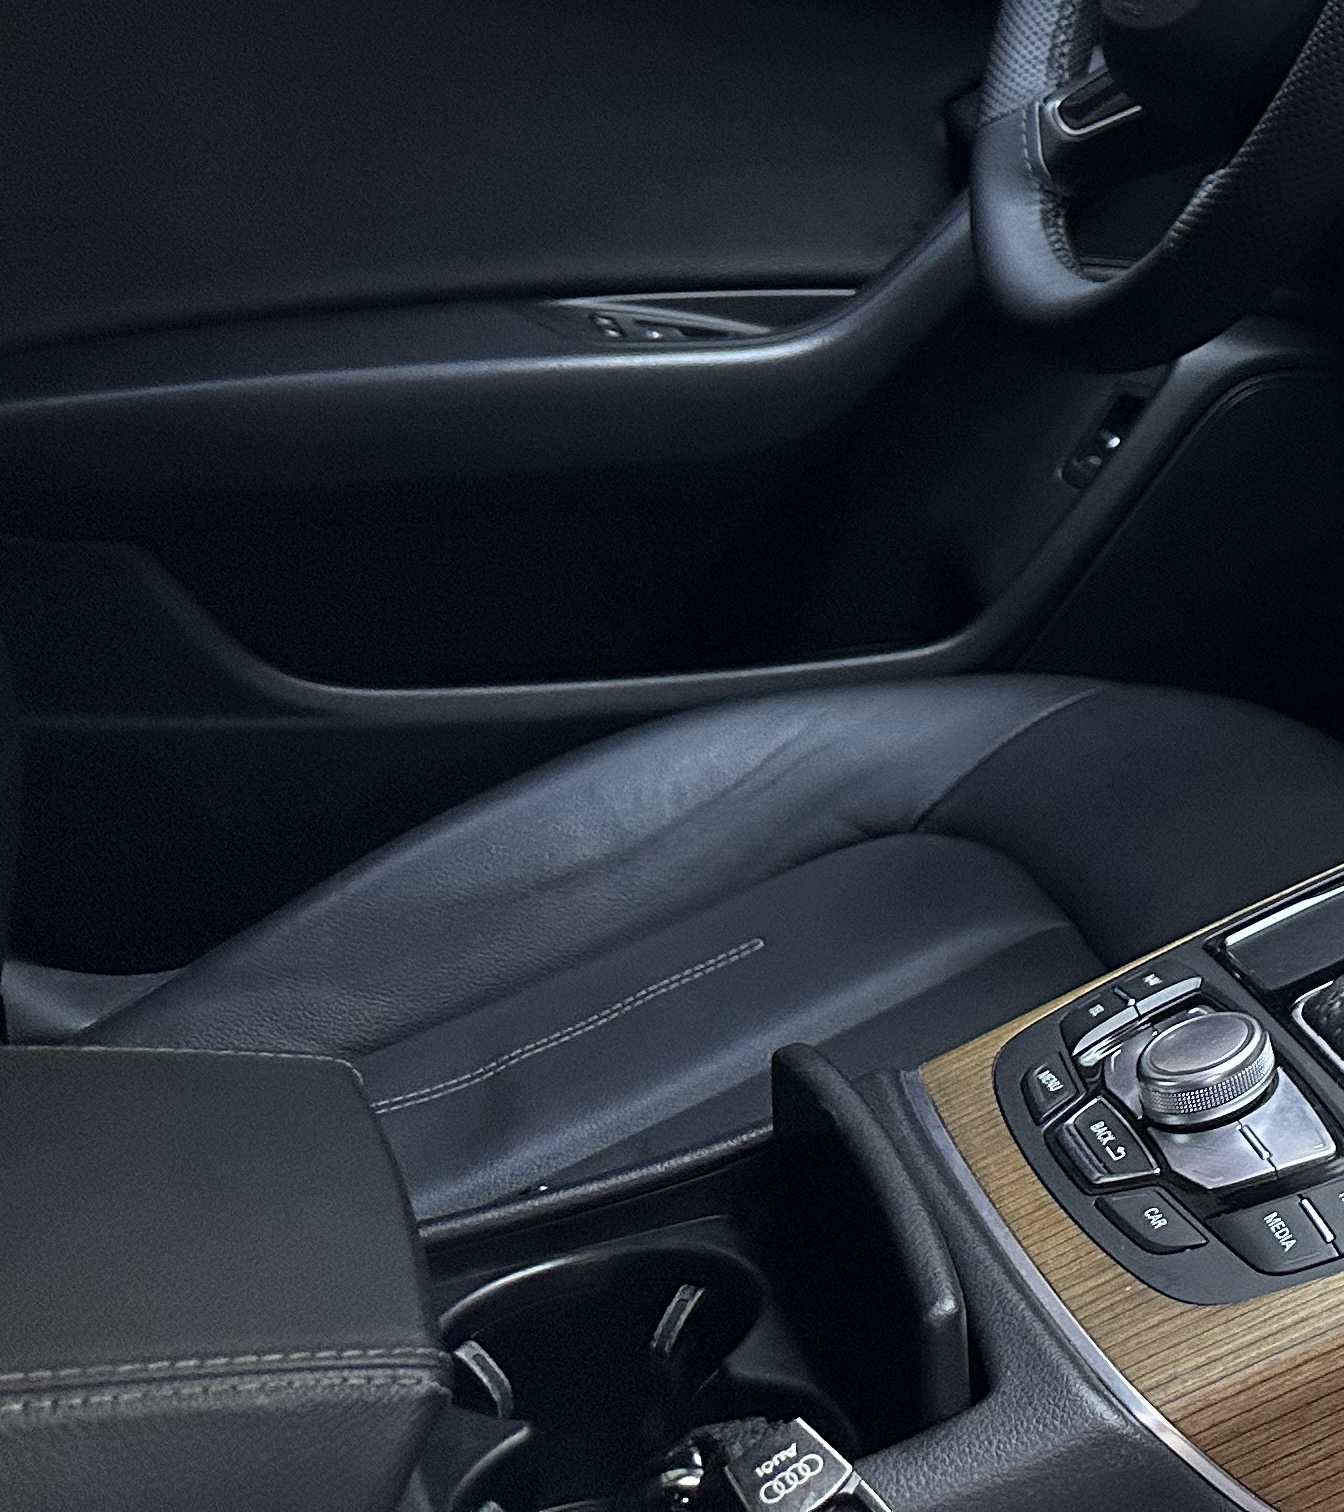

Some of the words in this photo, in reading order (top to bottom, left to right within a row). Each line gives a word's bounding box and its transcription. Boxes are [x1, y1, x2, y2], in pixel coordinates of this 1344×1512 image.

[1037, 1068, 1064, 1093] MENU
[1089, 1119, 1115, 1148] BACK
[1143, 1206, 1169, 1230] CAR
[1263, 1210, 1297, 1253] MEDIA
[754, 1441, 798, 1478] Audi
